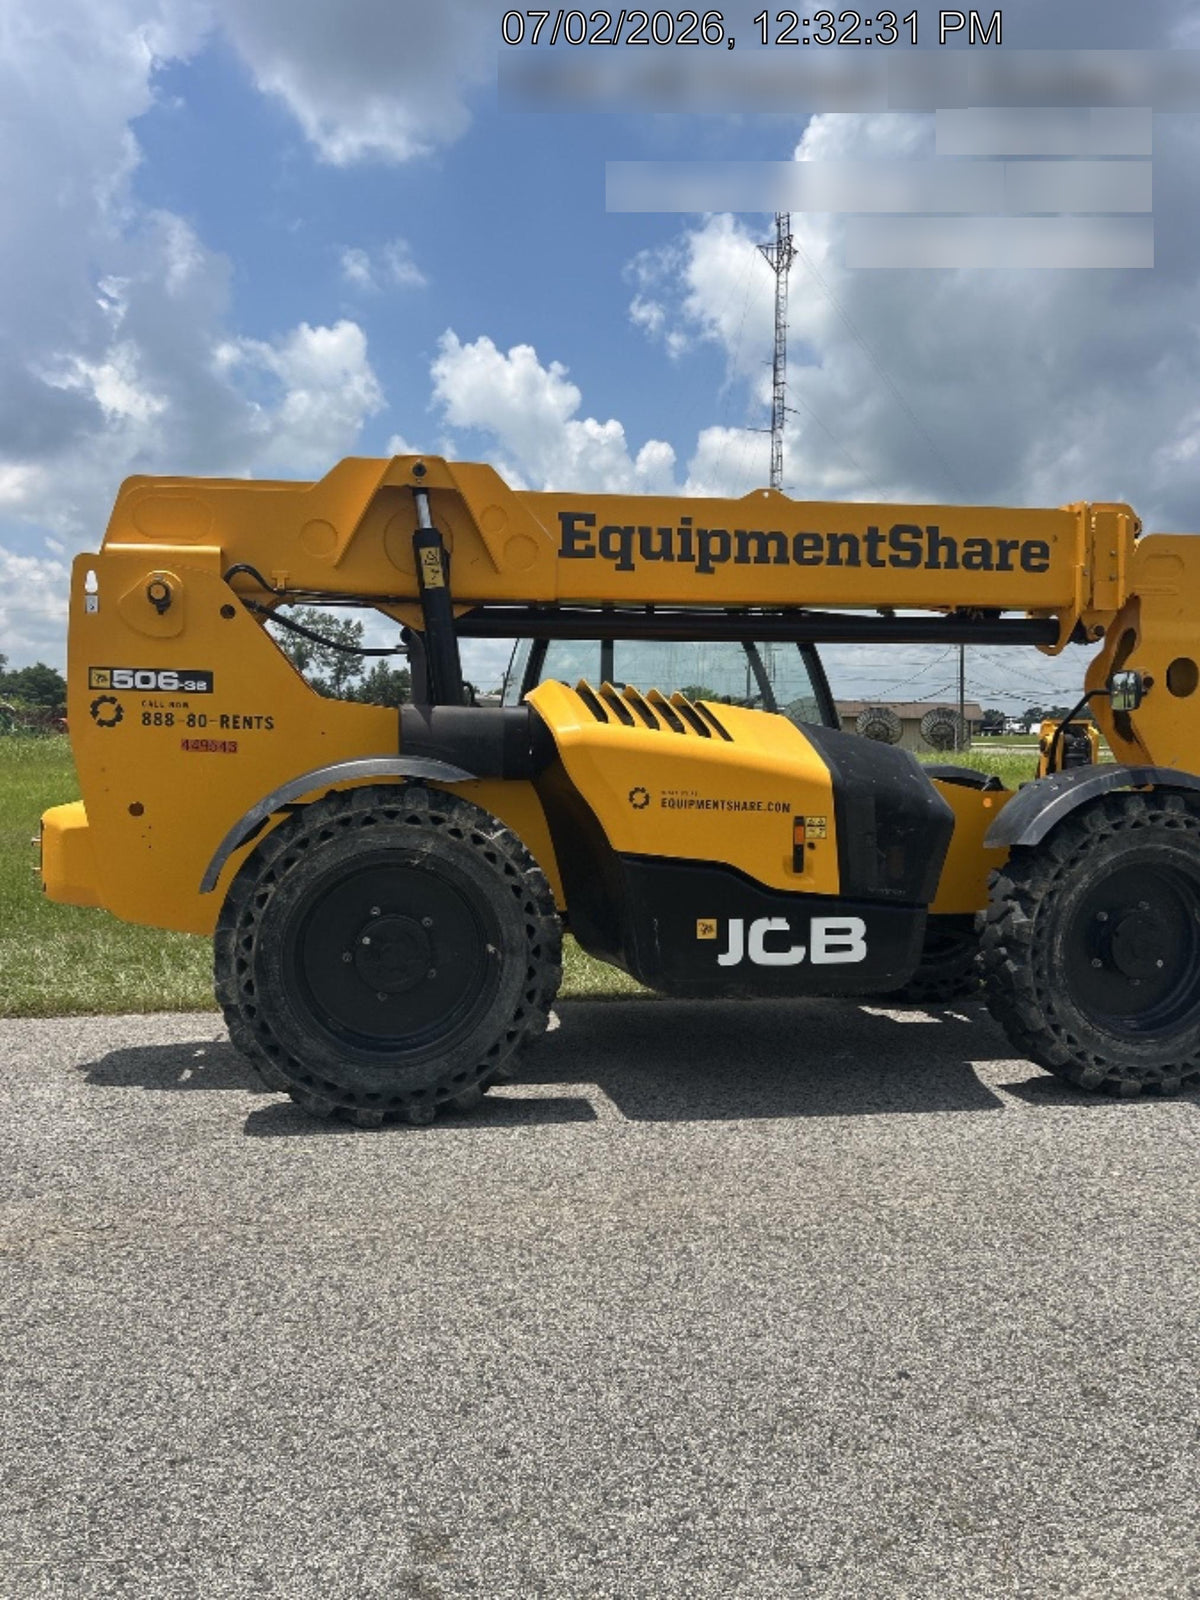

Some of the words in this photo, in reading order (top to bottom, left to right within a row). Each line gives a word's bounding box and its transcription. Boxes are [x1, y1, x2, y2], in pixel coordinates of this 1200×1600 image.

[557, 511, 1050, 575] EquipmentShare
[141, 711, 275, 731] 888-80-RENTS
[660, 797, 791, 813] EQUIPMENTSHARE.COM
[716, 915, 868, 967] JCB
